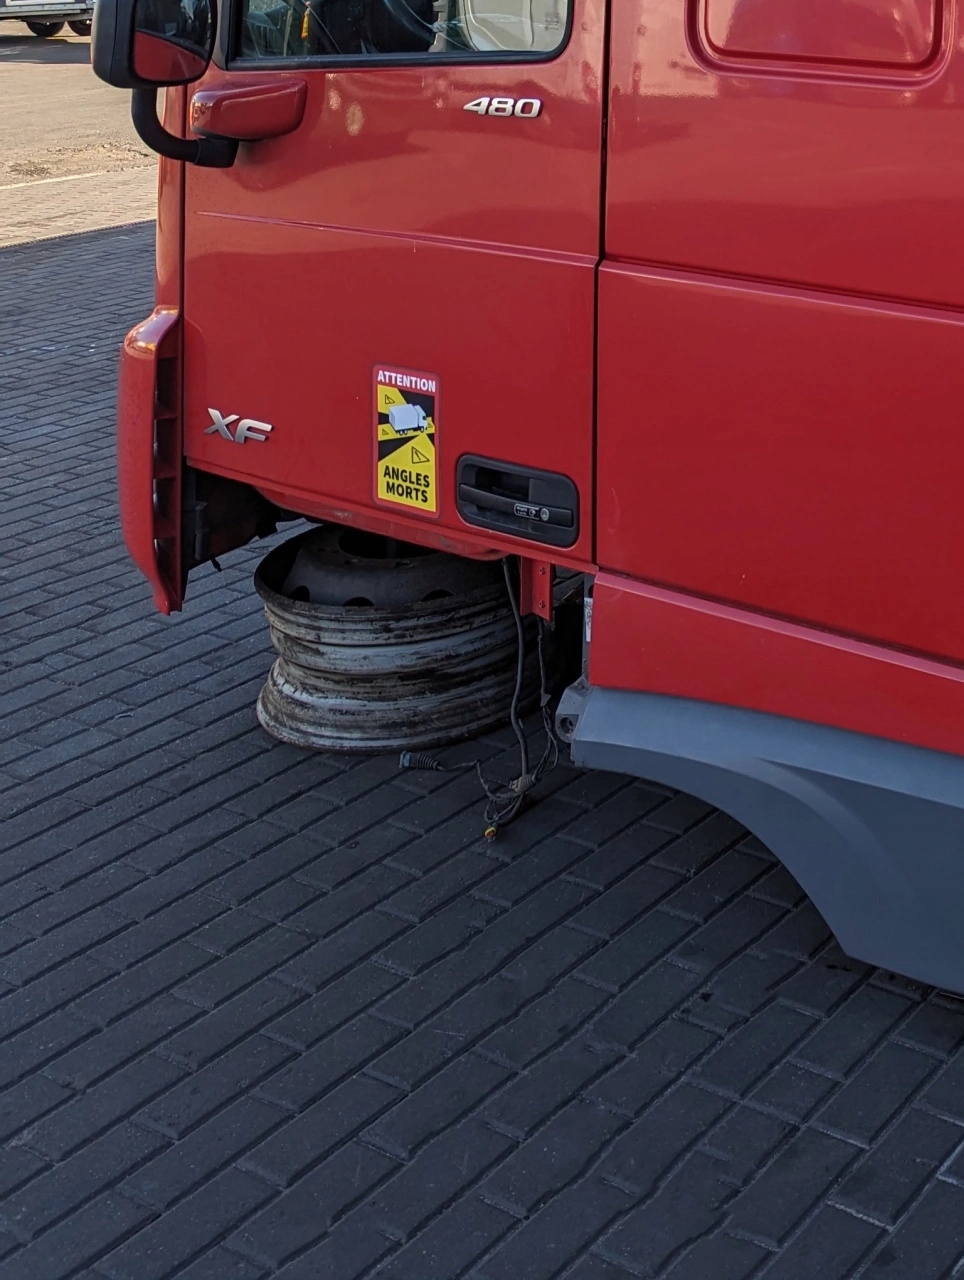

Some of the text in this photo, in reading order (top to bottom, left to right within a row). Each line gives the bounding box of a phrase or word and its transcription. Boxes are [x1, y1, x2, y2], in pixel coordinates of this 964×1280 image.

[463, 96, 542, 118] 480
[377, 370, 436, 392] ATTENTION
[203, 407, 273, 444] XF
[383, 464, 430, 488] ANGLES
[386, 481, 428, 503] MORTS
